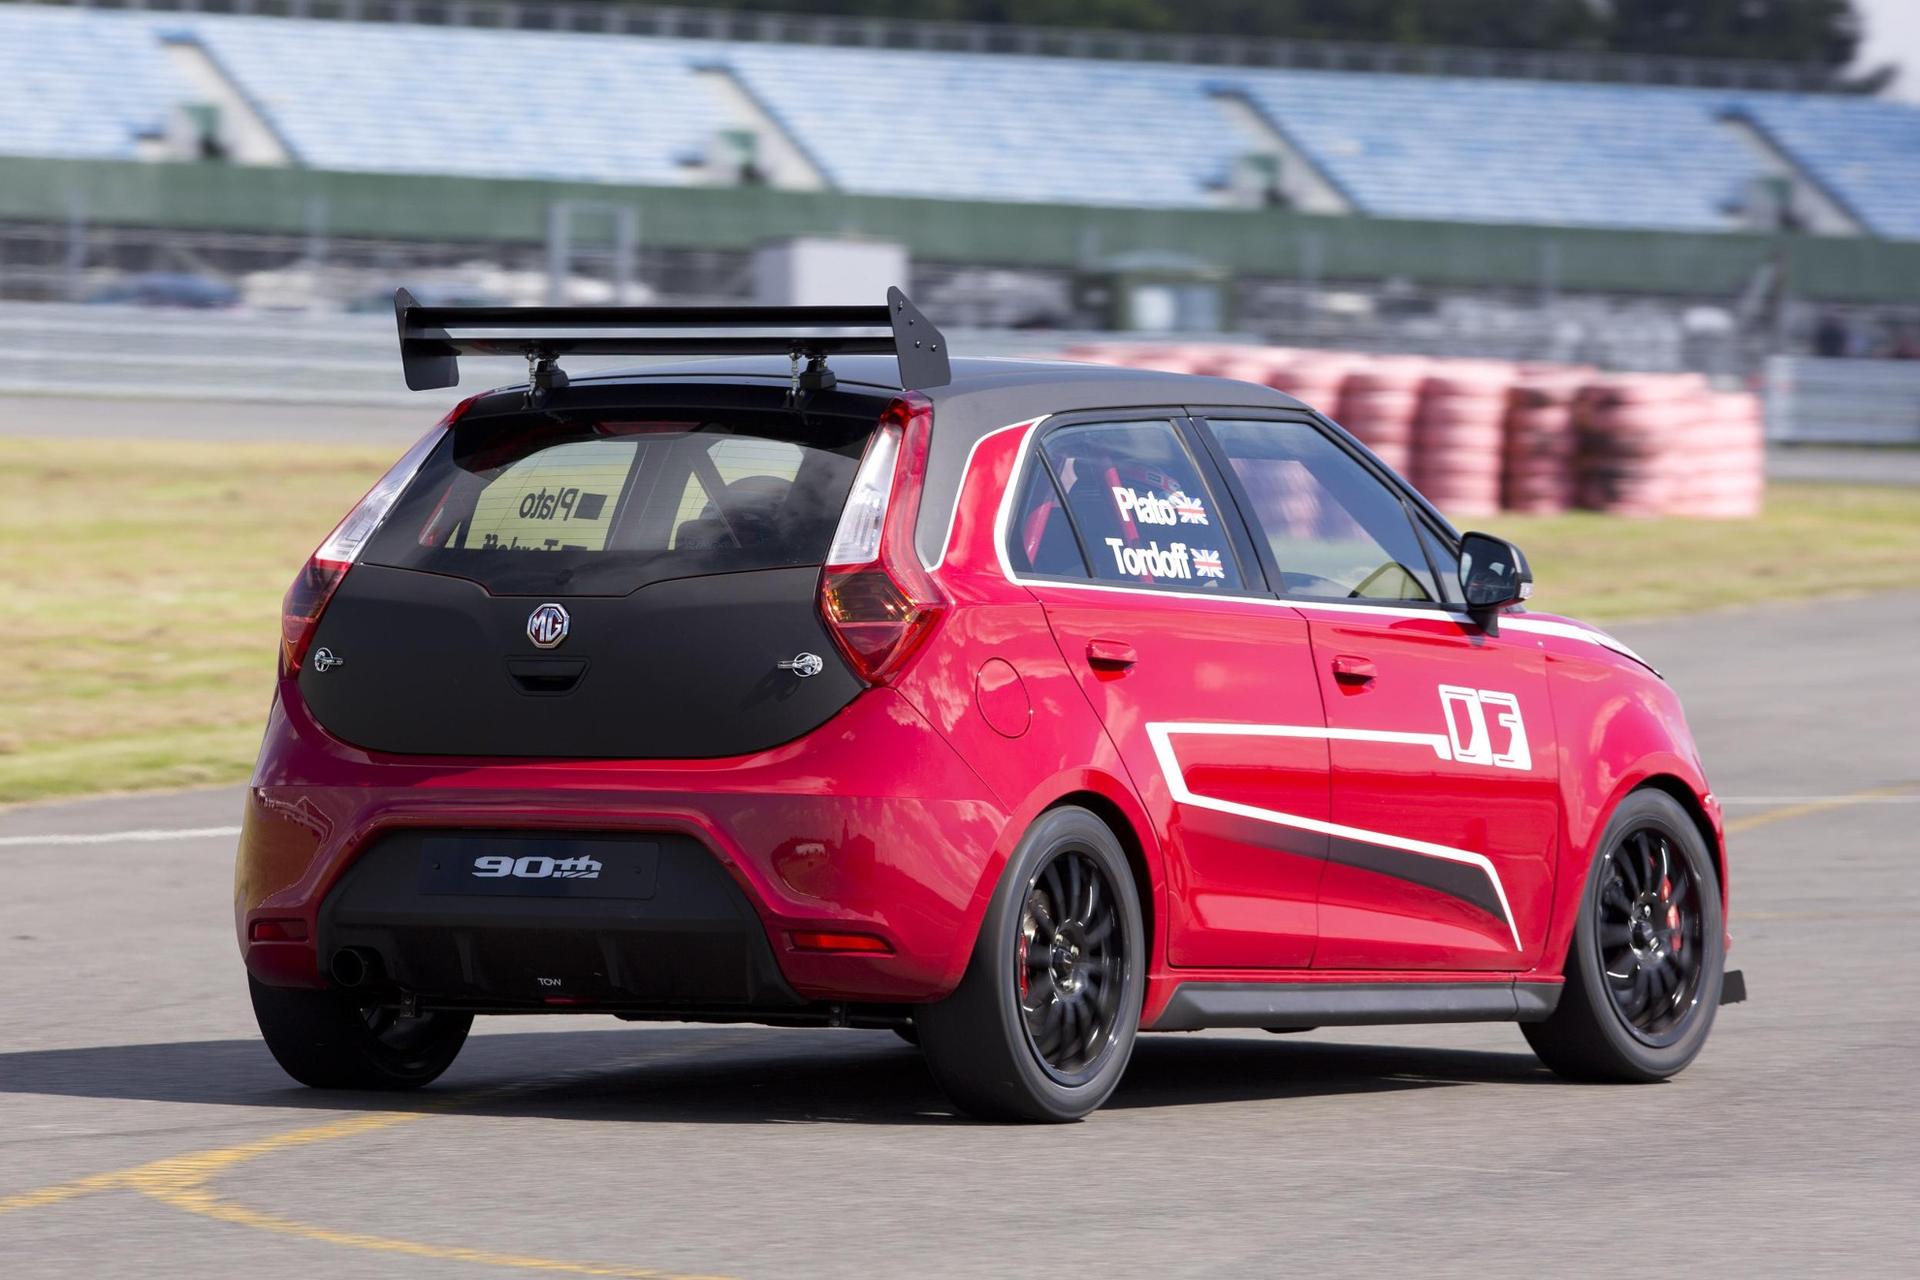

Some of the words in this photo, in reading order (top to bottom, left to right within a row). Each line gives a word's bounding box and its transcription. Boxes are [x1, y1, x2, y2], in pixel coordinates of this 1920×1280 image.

[1112, 487, 1177, 526] Plato
[1105, 537, 1192, 579] Tordoff
[530, 607, 564, 642] MG
[1438, 684, 1532, 771] 03
[472, 855, 603, 879] 90th
[537, 977, 562, 987] TOW
